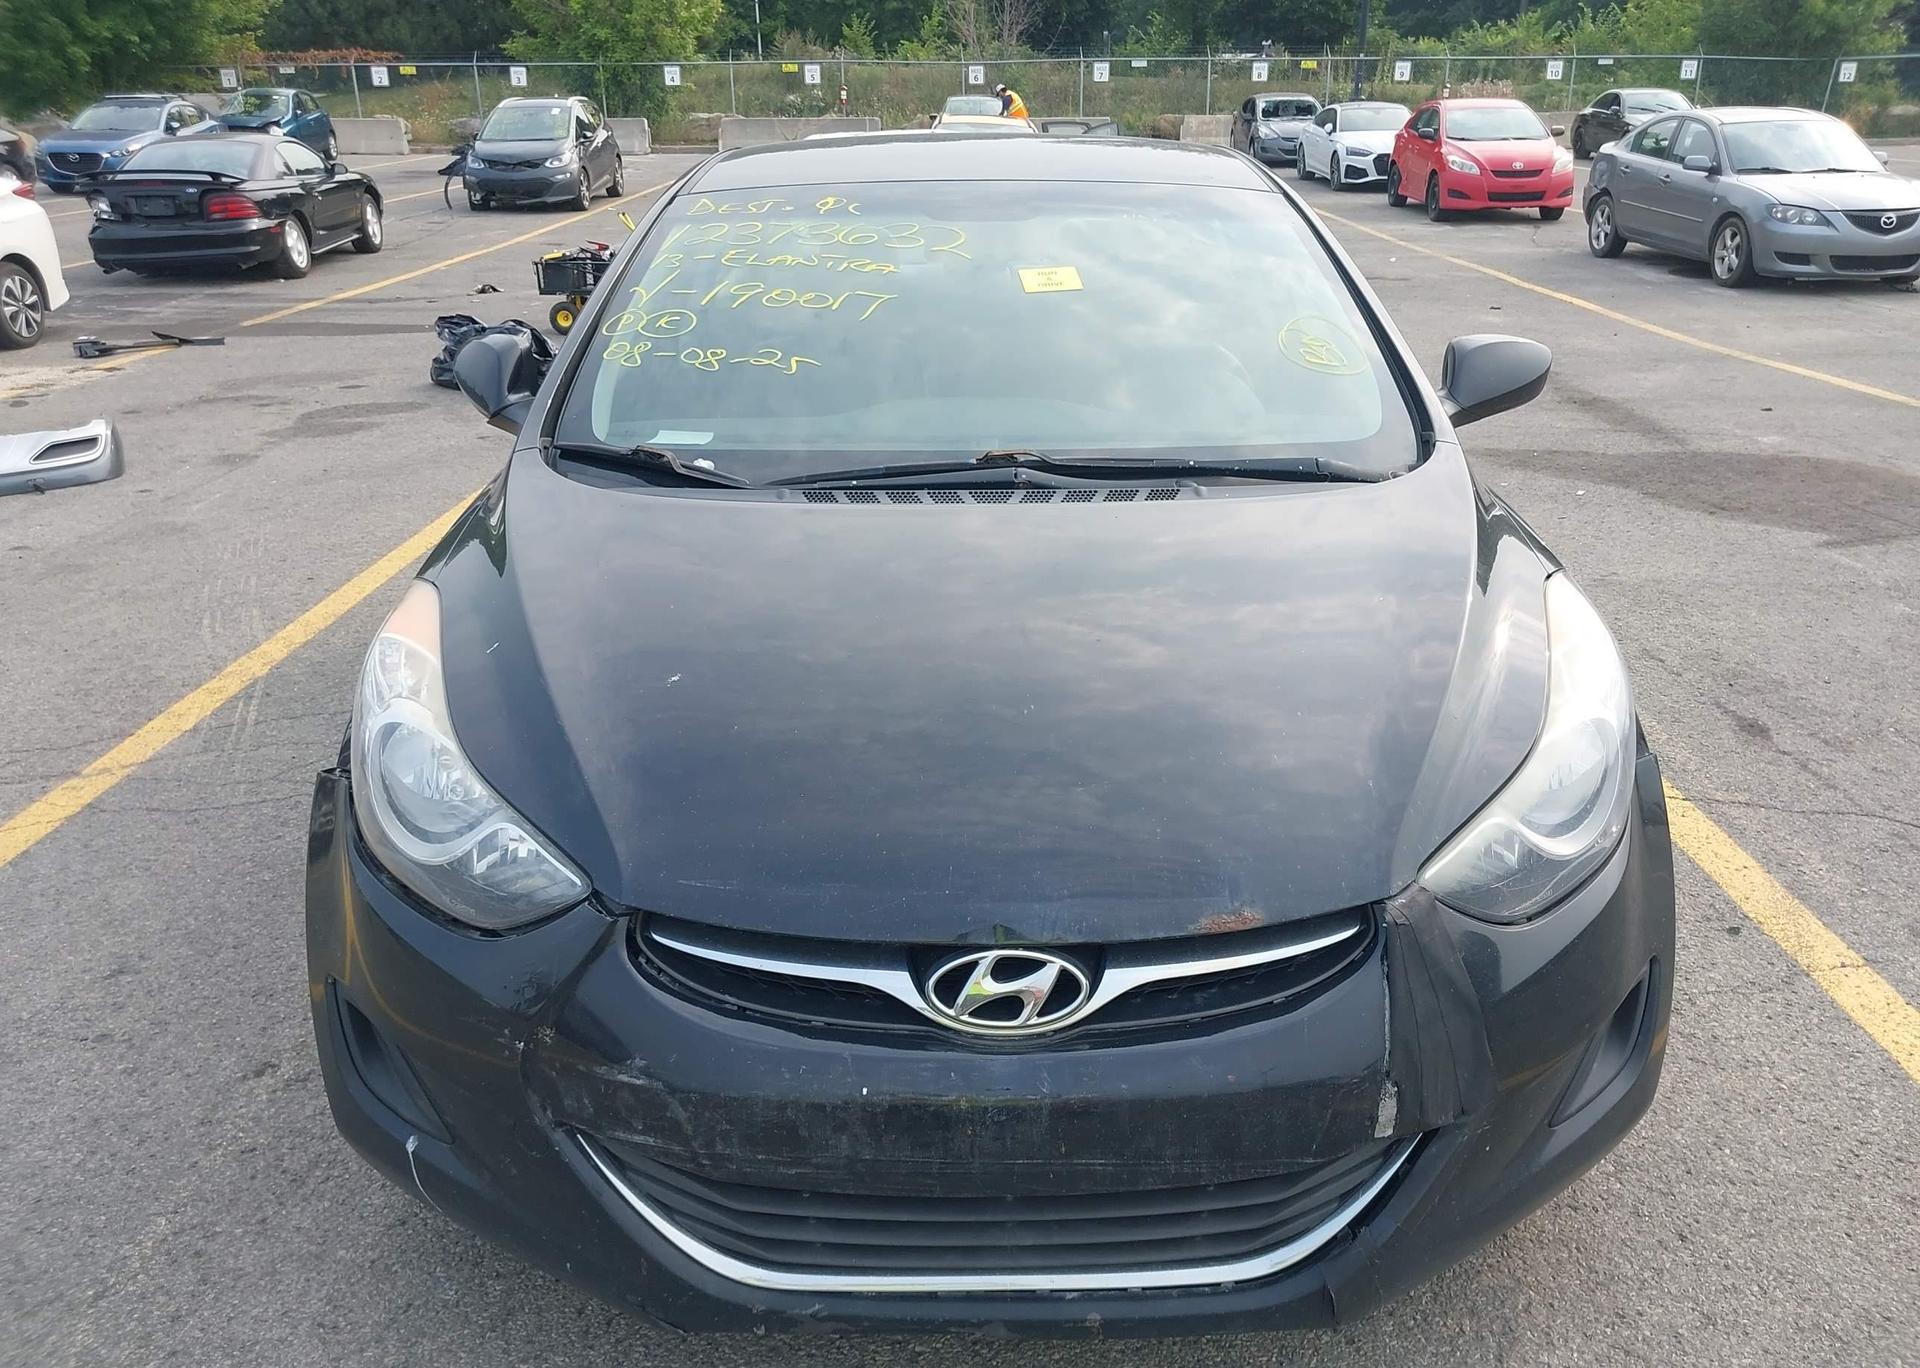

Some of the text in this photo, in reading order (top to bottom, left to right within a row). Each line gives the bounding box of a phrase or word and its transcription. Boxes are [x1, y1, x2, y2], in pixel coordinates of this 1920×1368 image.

[1098, 72, 1104, 80] 7
[1257, 71, 1262, 79] 8
[1399, 71, 1405, 79] 9
[1550, 70, 1560, 78] 10
[1842, 72, 1852, 80] 12
[515, 76, 521, 84] 3
[669, 76, 675, 84] 4
[660, 222, 974, 261] 12373632
